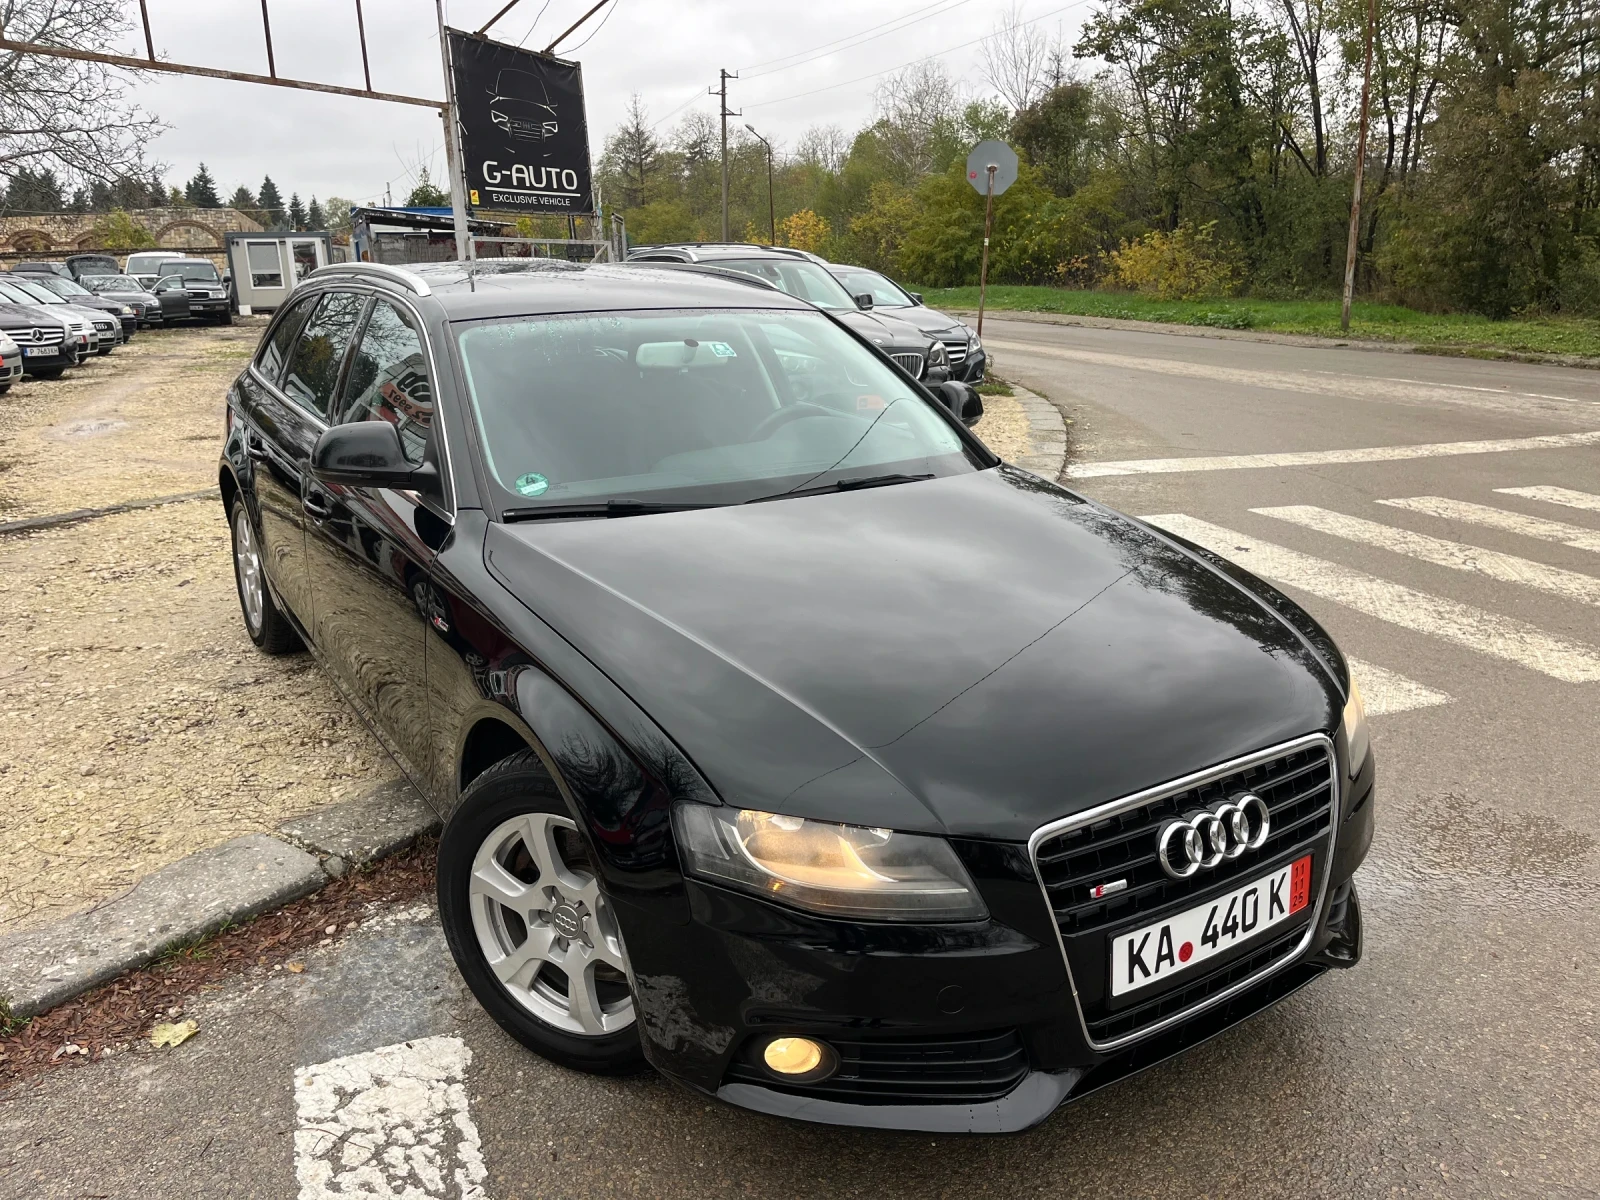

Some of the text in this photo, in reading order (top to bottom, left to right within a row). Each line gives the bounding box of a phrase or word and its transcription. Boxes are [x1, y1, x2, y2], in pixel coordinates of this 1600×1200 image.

[482, 160, 578, 190] G-AUTO
[492, 193, 538, 205] EXCLUSIVE
[539, 195, 571, 206] VEHICLE
[1295, 862, 1305, 879] 11
[1294, 877, 1304, 893] 11
[1292, 891, 1304, 908] 25
[1127, 871, 1287, 985] KA 440 K
